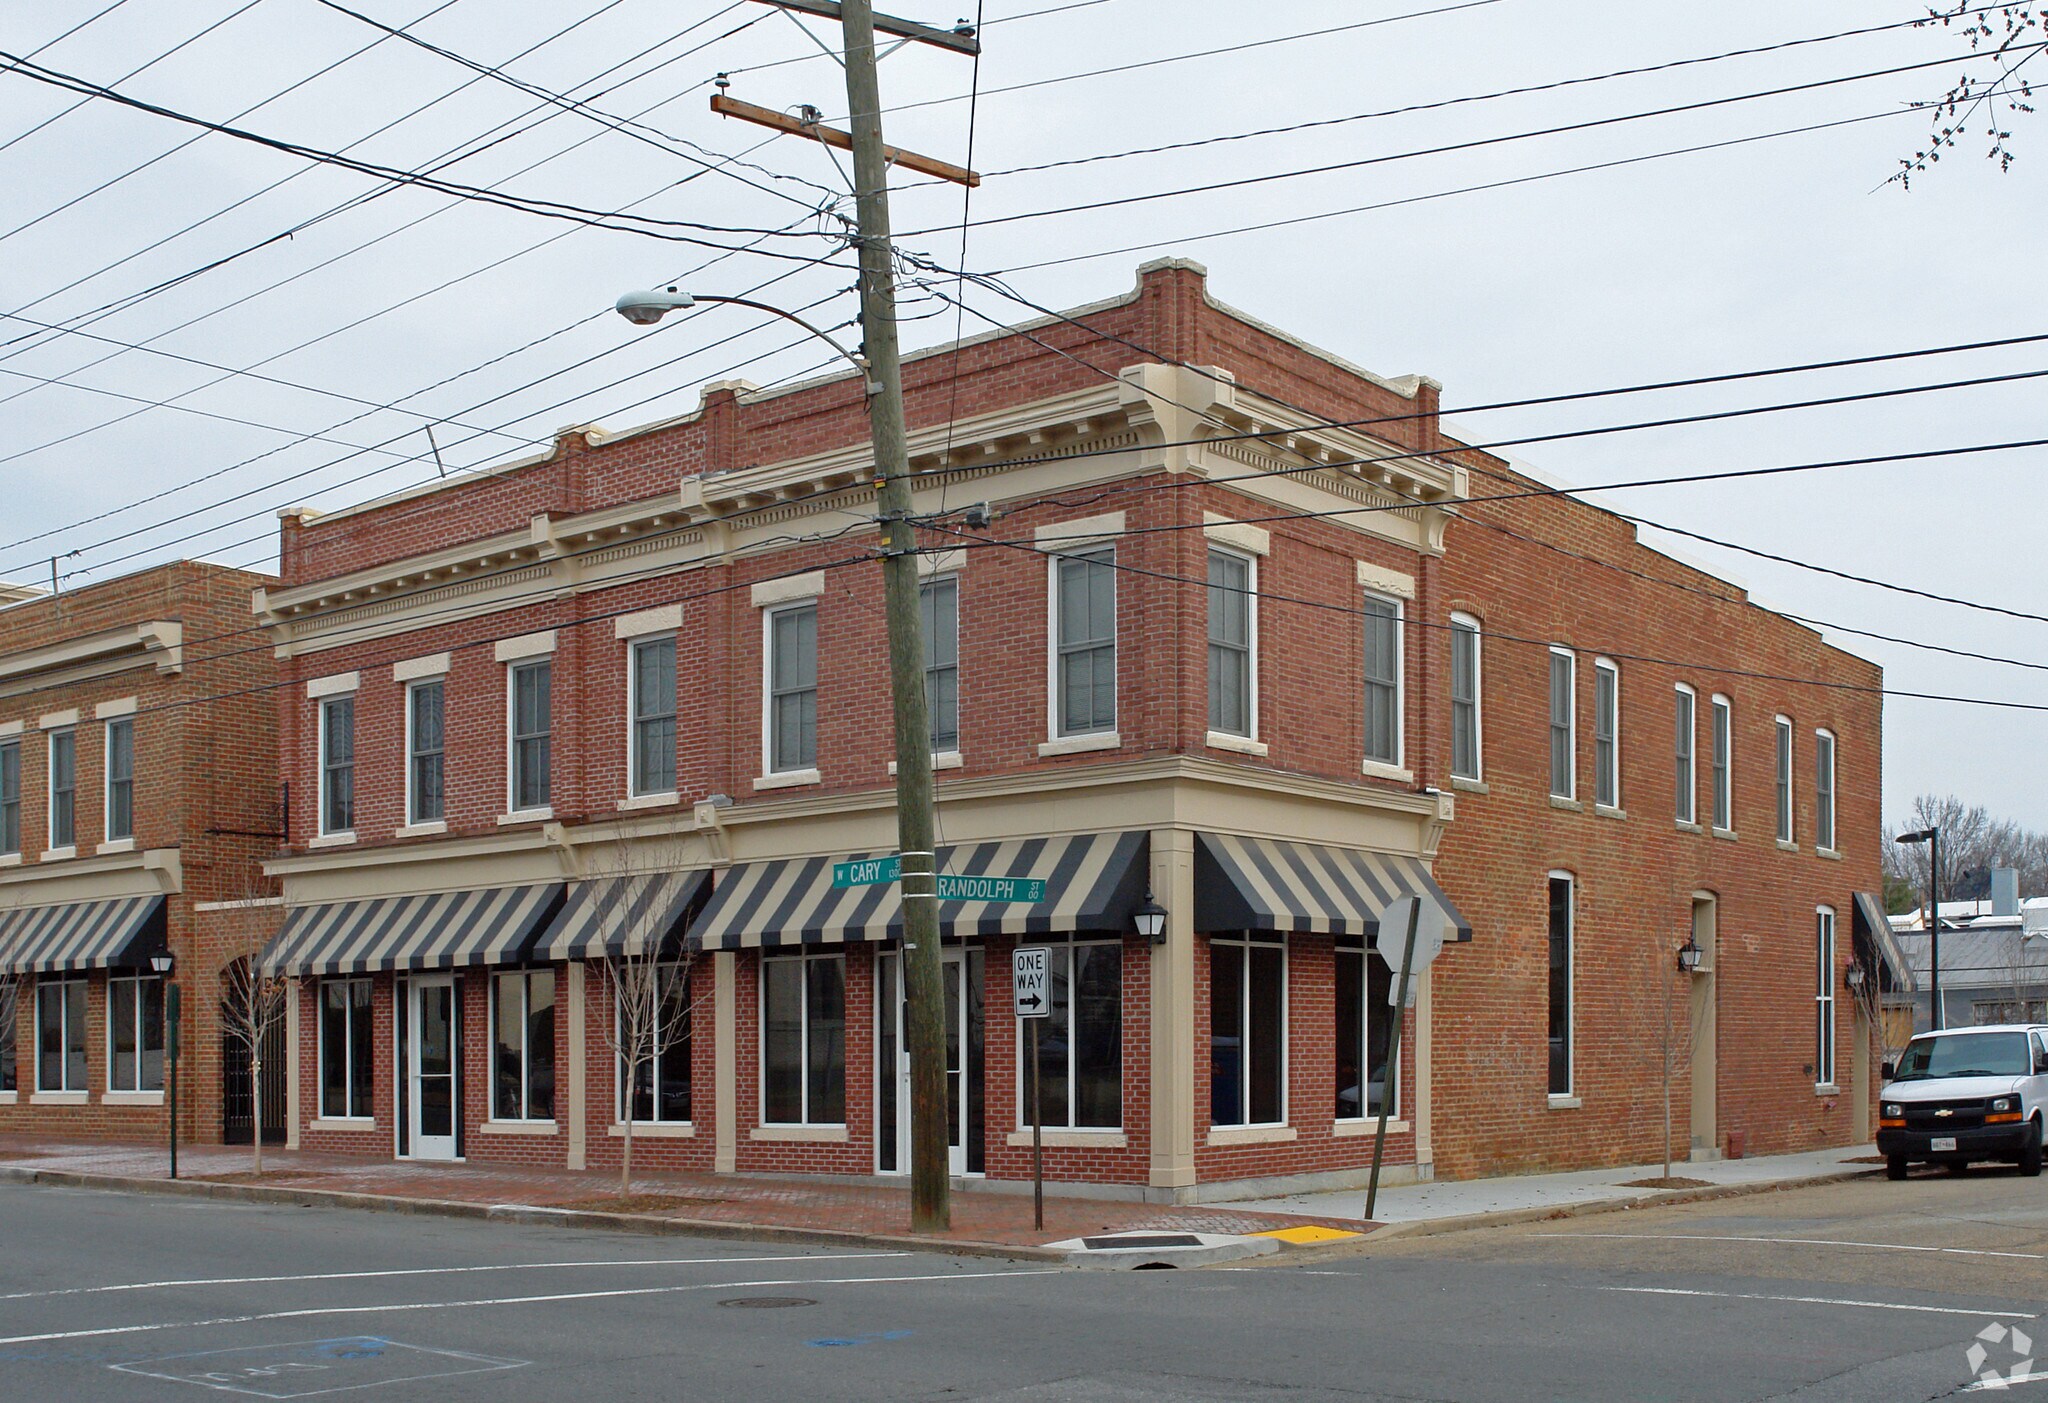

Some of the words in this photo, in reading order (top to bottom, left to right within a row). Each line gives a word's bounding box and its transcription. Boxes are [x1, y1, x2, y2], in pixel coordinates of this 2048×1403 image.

[837, 870, 843, 881] W
[850, 861, 881, 883] CARY
[938, 878, 1014, 899] RANDOLPH
[1031, 881, 1040, 891] ST
[1017, 954, 1043, 971] ONE
[1017, 973, 1043, 990] WAY
